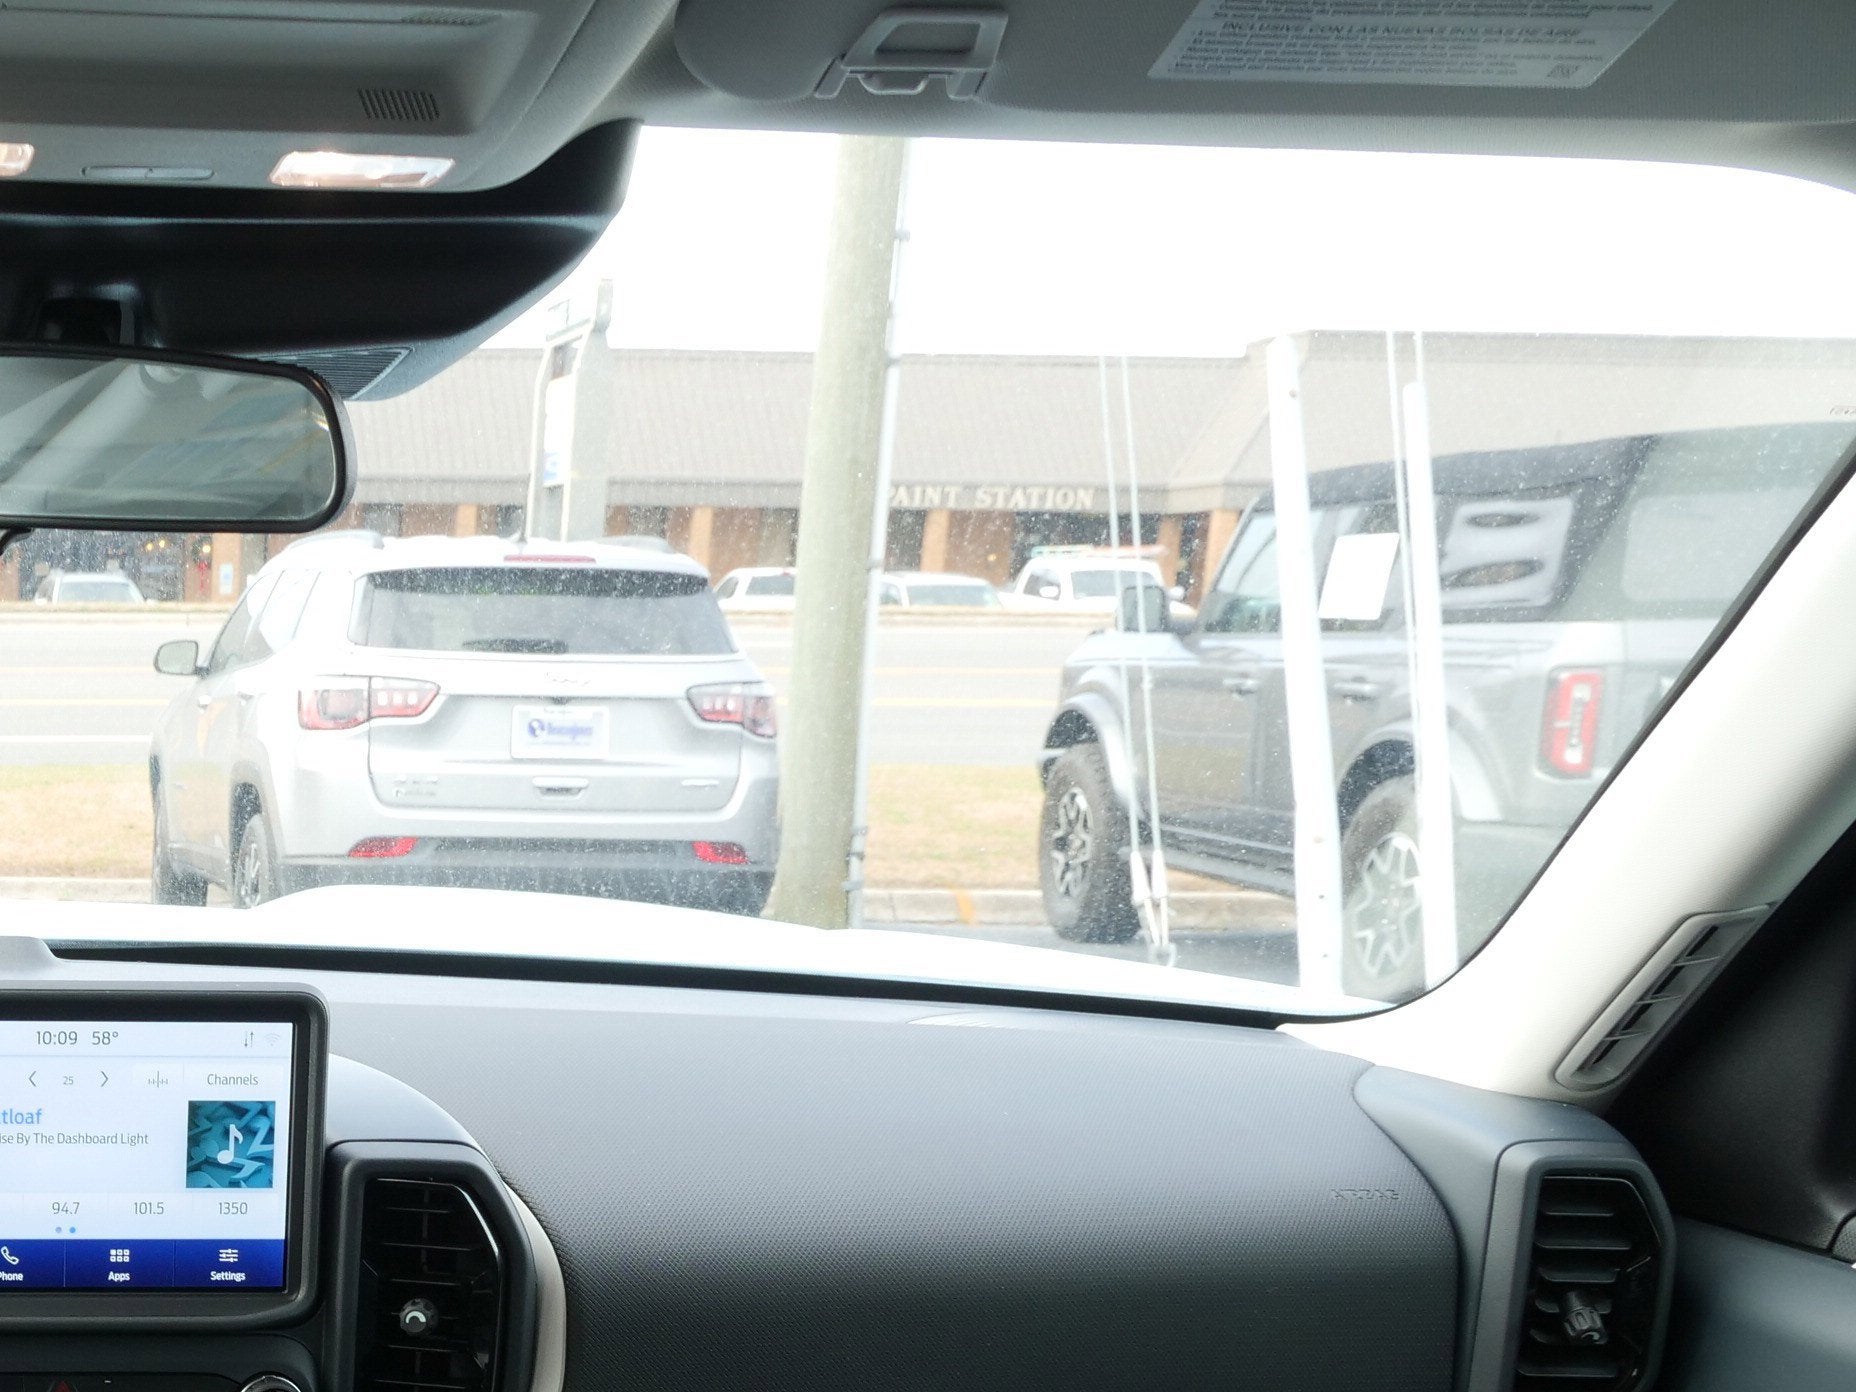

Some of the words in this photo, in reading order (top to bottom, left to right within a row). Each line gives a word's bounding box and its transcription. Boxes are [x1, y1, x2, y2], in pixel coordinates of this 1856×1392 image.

[975, 486, 1095, 511] STATION
[36, 1030, 78, 1046] 10:09
[92, 1030, 119, 1046] 58°
[62, 1075, 75, 1086] 25
[206, 1072, 260, 1087] Channels
[16, 1132, 31, 1146] By
[33, 1132, 55, 1145] The
[57, 1132, 118, 1145] Dashboard
[120, 1132, 149, 1146] Light
[52, 1201, 80, 1215] 94.7
[133, 1201, 165, 1215] 101.5
[218, 1201, 249, 1215] 1350
[107, 1271, 131, 1283] Apps
[210, 1270, 246, 1283] Settings
